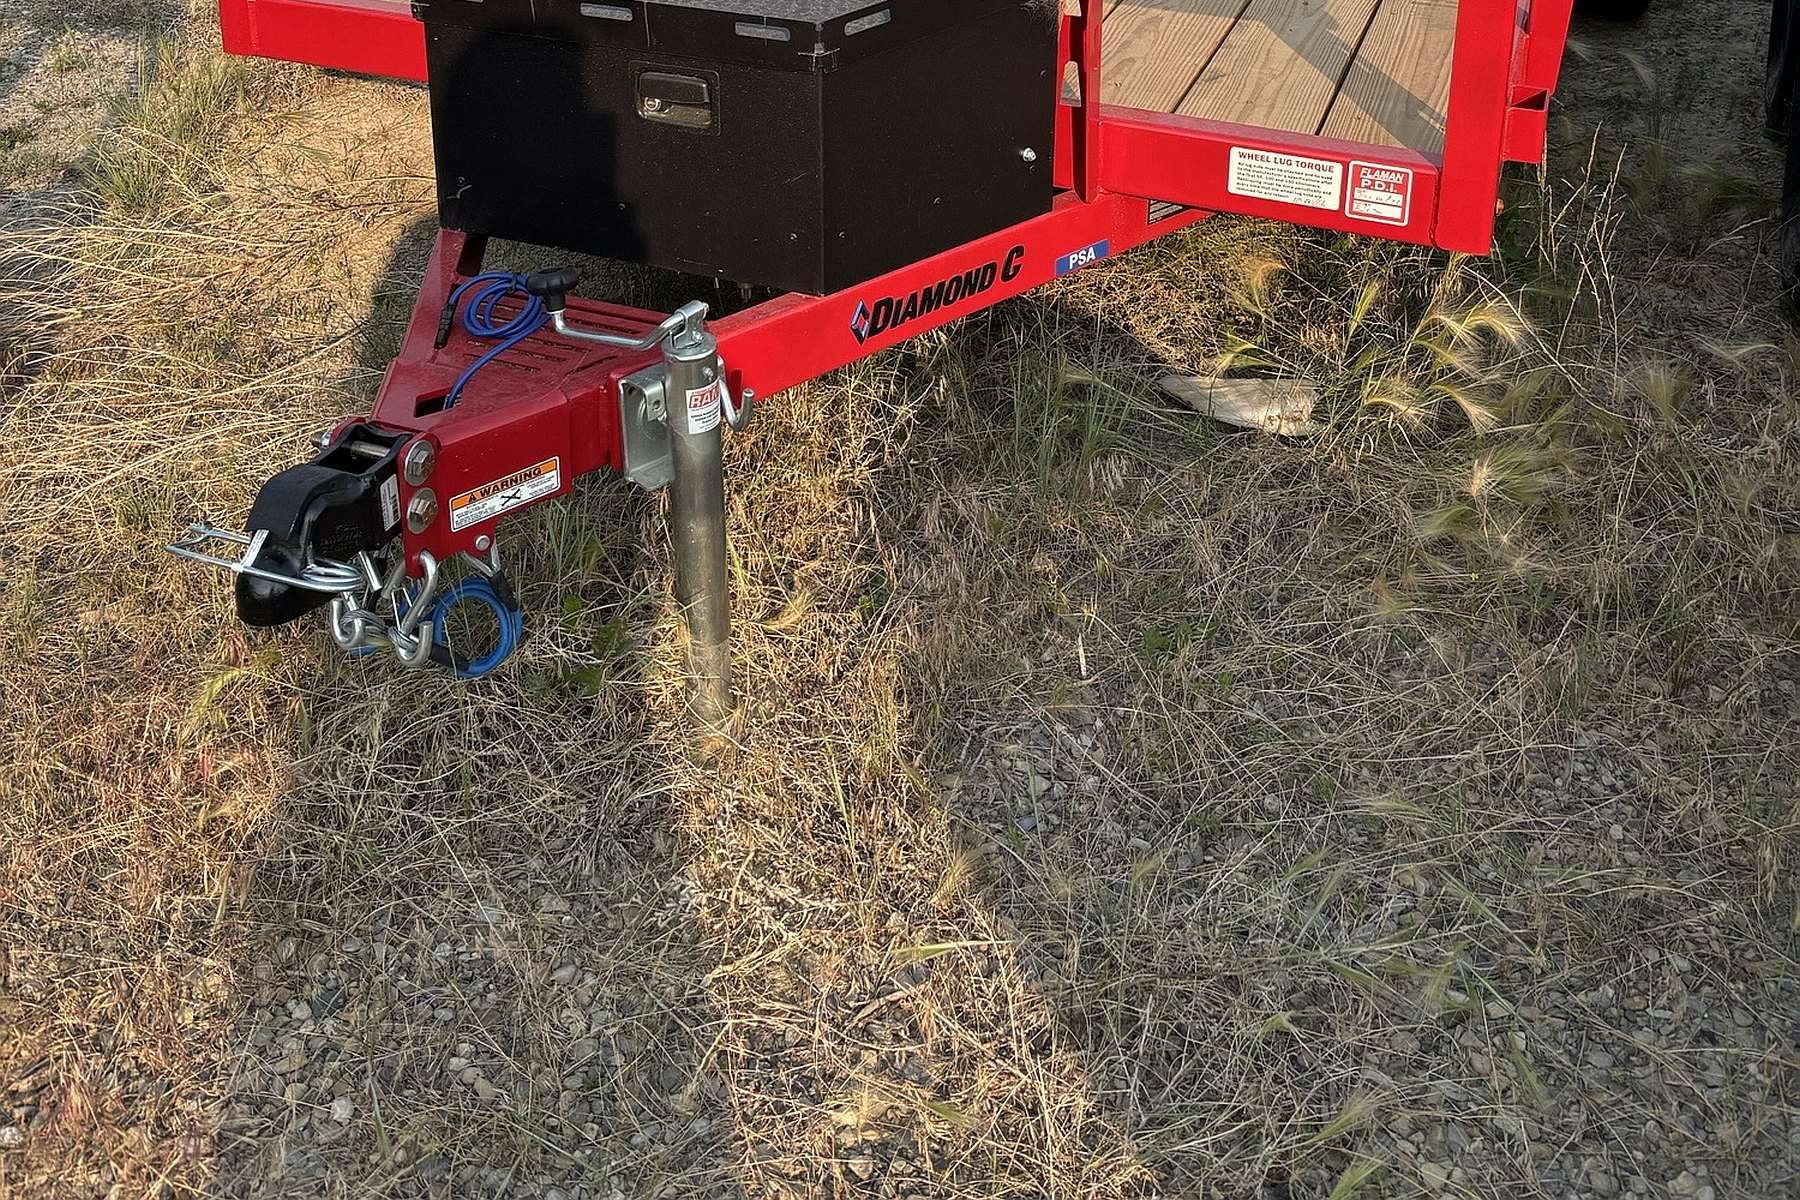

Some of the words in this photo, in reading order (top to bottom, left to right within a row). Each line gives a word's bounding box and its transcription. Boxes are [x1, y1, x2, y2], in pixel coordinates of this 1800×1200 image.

[1238, 150, 1271, 163] WHEEL
[1273, 156, 1292, 166] LUG
[1295, 160, 1334, 173] TORQUE
[1360, 167, 1404, 182] FLAMAN
[1361, 179, 1398, 193] P.D.I.
[1068, 246, 1097, 270] PSA
[868, 262, 997, 338] DIAMOND
[1000, 245, 1025, 283] C
[480, 467, 542, 497] WARNING
